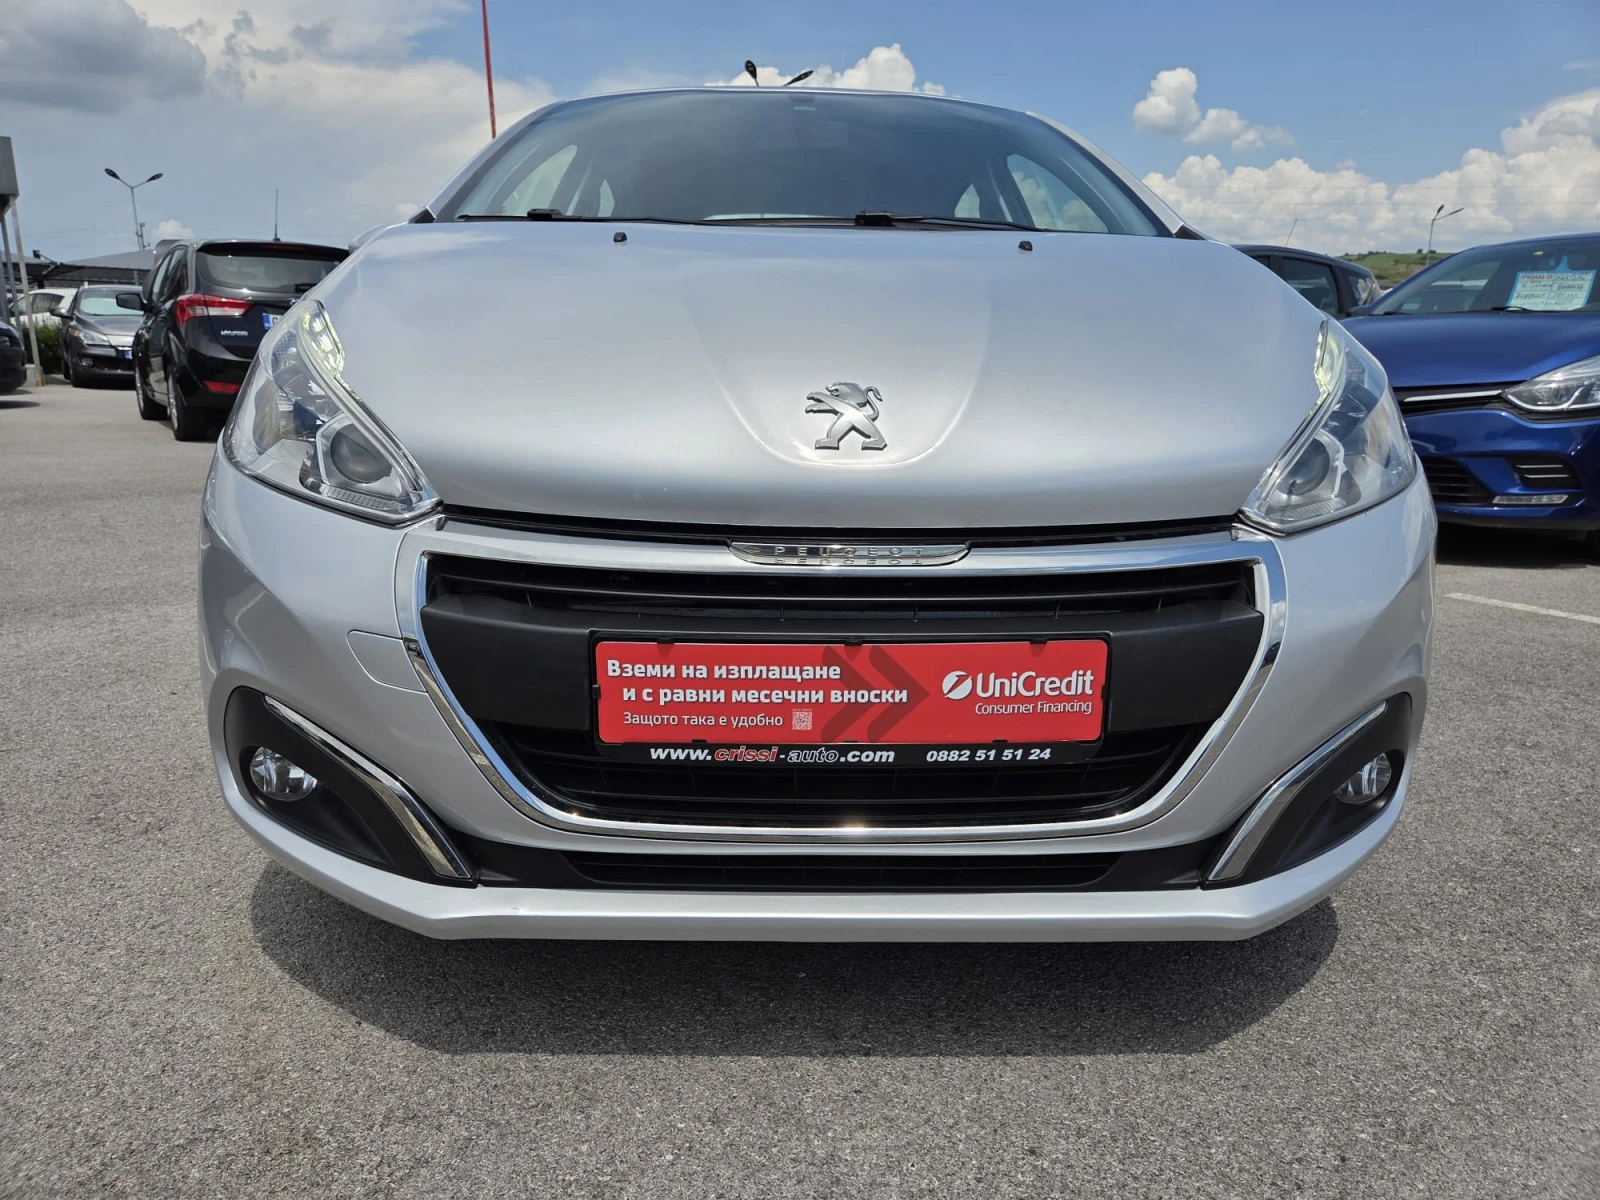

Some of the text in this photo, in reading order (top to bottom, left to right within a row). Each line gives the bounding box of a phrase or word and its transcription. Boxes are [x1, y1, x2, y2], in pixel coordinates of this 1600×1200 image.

[774, 546, 924, 557] PEUGEOT
[607, 659, 841, 682] Вземи на изплащане
[976, 669, 1094, 698] UniCredit
[622, 687, 908, 706] и с равни месечни вноски
[975, 700, 1092, 715] Consumer Financing
[623, 711, 783, 728] Защото така е удобно
[650, 746, 895, 763] www.crissi-auto.com
[926, 748, 1051, 763] 0882 51 51 24
